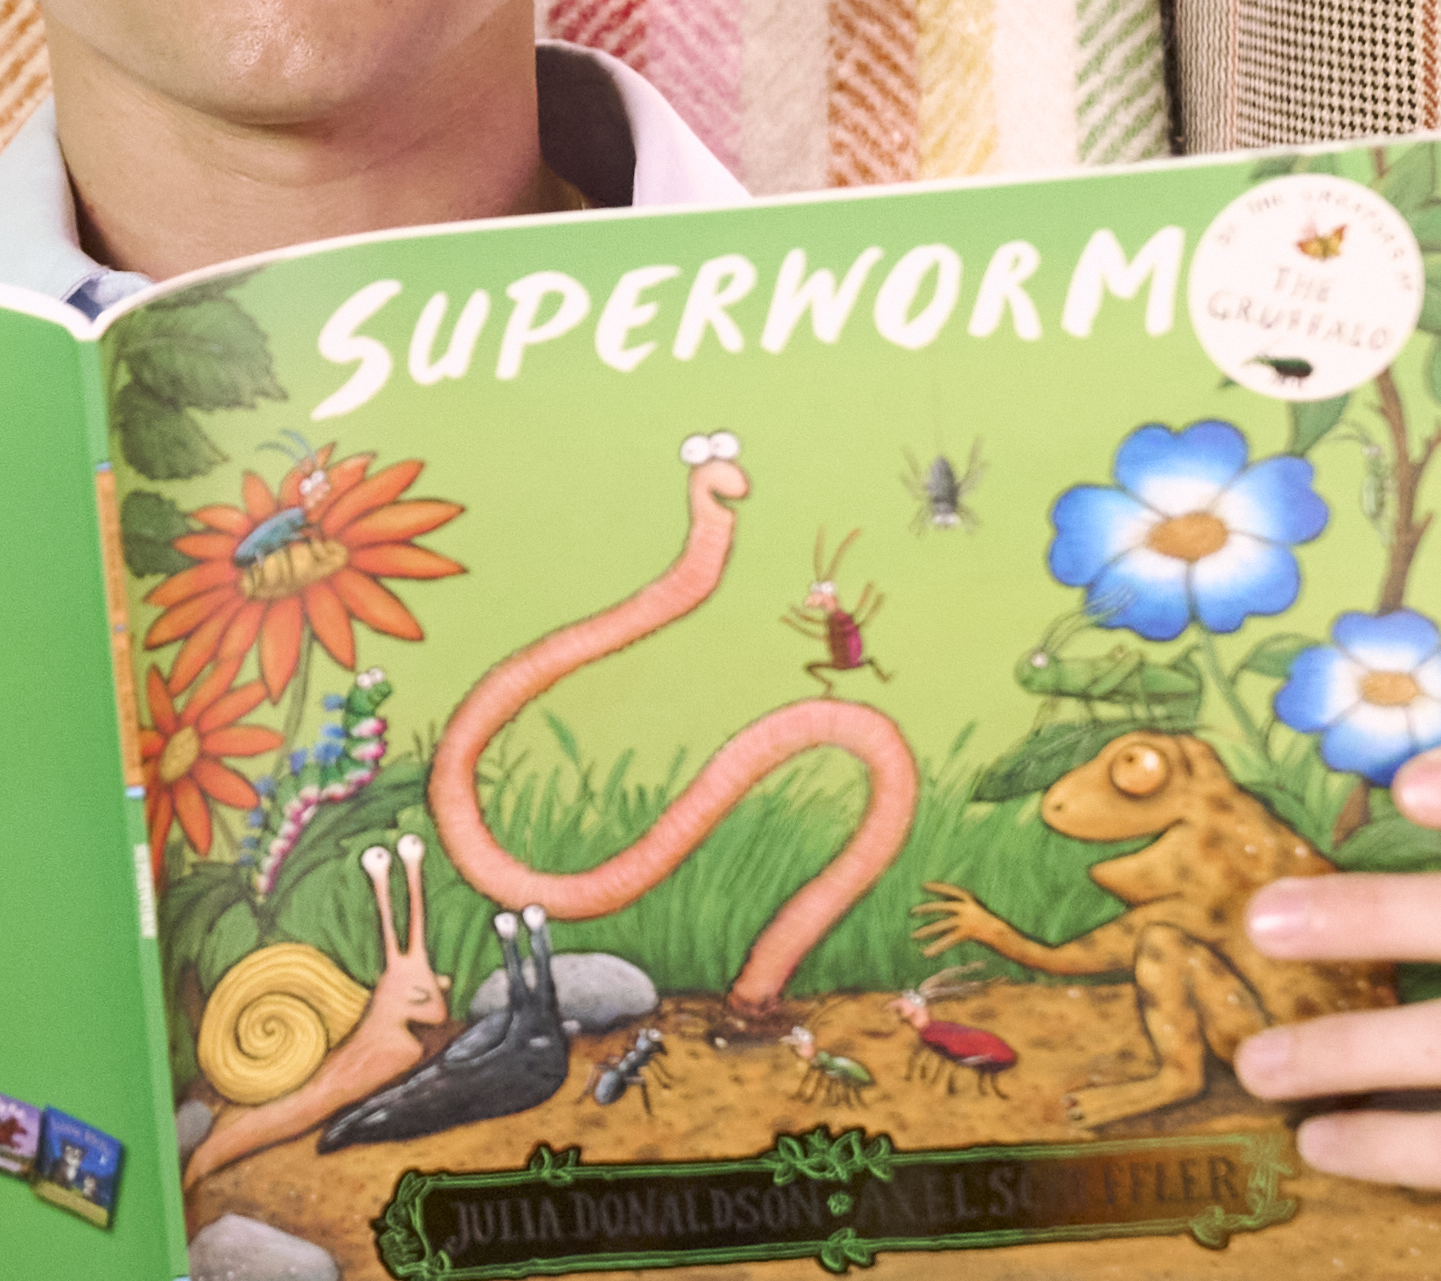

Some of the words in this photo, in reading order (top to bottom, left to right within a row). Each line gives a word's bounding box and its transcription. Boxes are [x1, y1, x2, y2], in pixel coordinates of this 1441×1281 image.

[1272, 265, 1334, 304] THE
[315, 226, 1184, 420] SUPERWORM
[1207, 289, 1391, 351] GRUFFALO
[443, 1195, 562, 1259] JULIA
[569, 1182, 825, 1242] DONALDSON
[853, 1171, 981, 1227] AXEL
